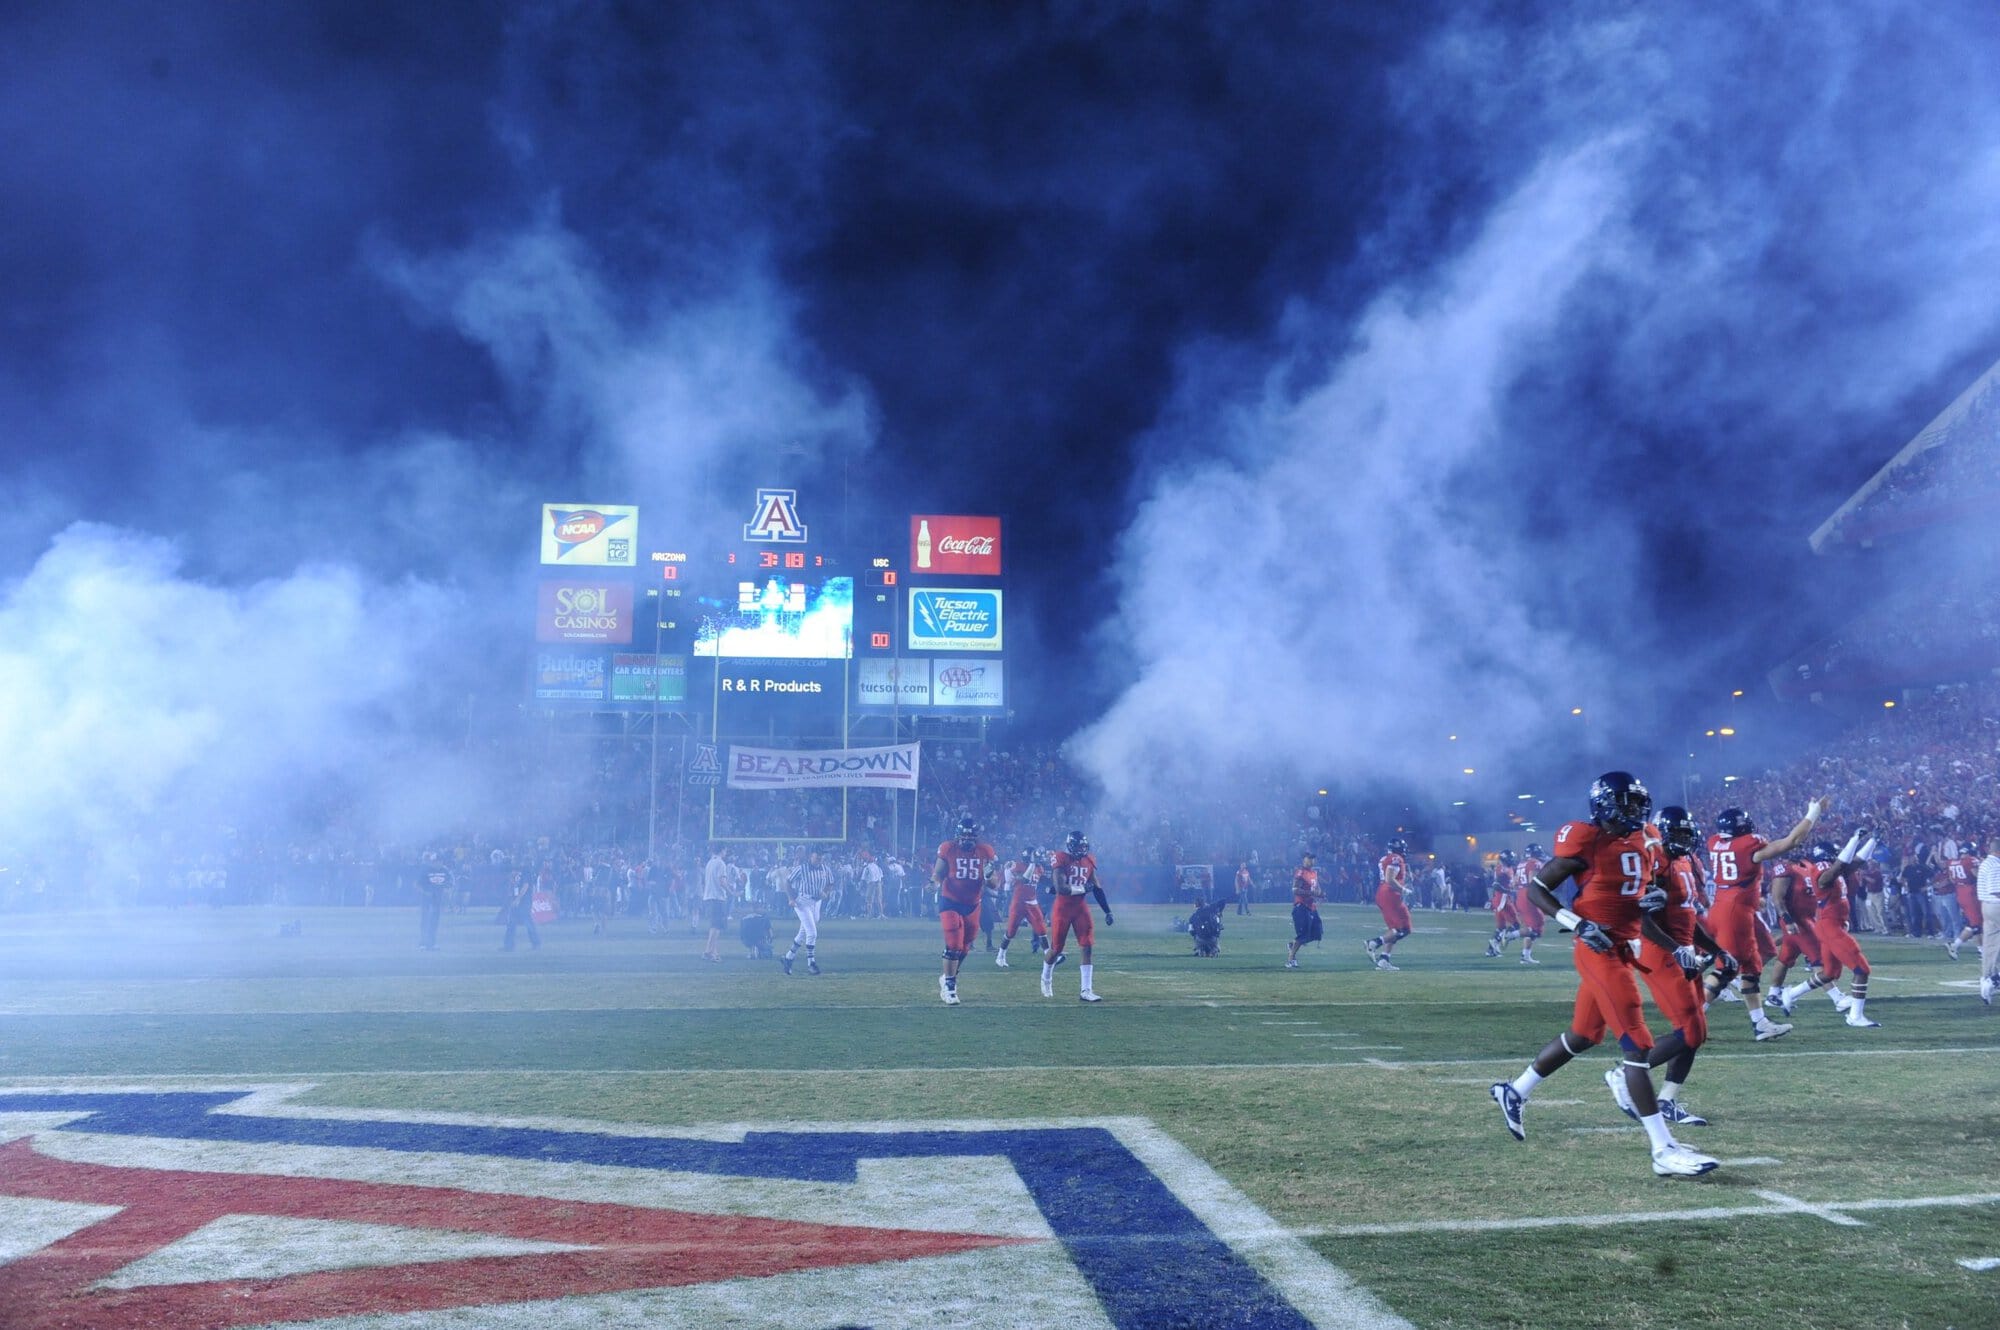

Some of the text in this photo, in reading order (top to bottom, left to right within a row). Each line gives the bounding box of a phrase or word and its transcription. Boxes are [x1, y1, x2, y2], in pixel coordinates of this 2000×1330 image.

[562, 523, 597, 536] NCAA
[938, 535, 996, 555] Coca-Cola
[609, 550, 628, 558] 10
[651, 552, 687, 562] ARIZONA
[728, 553, 736, 564] 3
[815, 556, 822, 566] 3
[873, 558, 890, 567] USC
[556, 588, 617, 617] SOL
[935, 597, 978, 610] Tucson
[939, 609, 990, 621] Electric
[554, 616, 617, 630] CASINOS
[944, 620, 989, 632] Power
[538, 653, 604, 677] Budget
[615, 666, 630, 675] CAR
[632, 667, 650, 675] CARE
[940, 667, 971, 688] AAA
[722, 679, 822, 693] R & R Products
[955, 690, 999, 699] Insurance
[688, 775, 721, 786] CLUB
[1557, 825, 1573, 843] 9
[955, 858, 981, 880] 55
[1710, 851, 1738, 881] 76
[1949, 864, 1967, 880] 78
[1068, 865, 1089, 886] 25
[1620, 852, 1642, 896] 9
